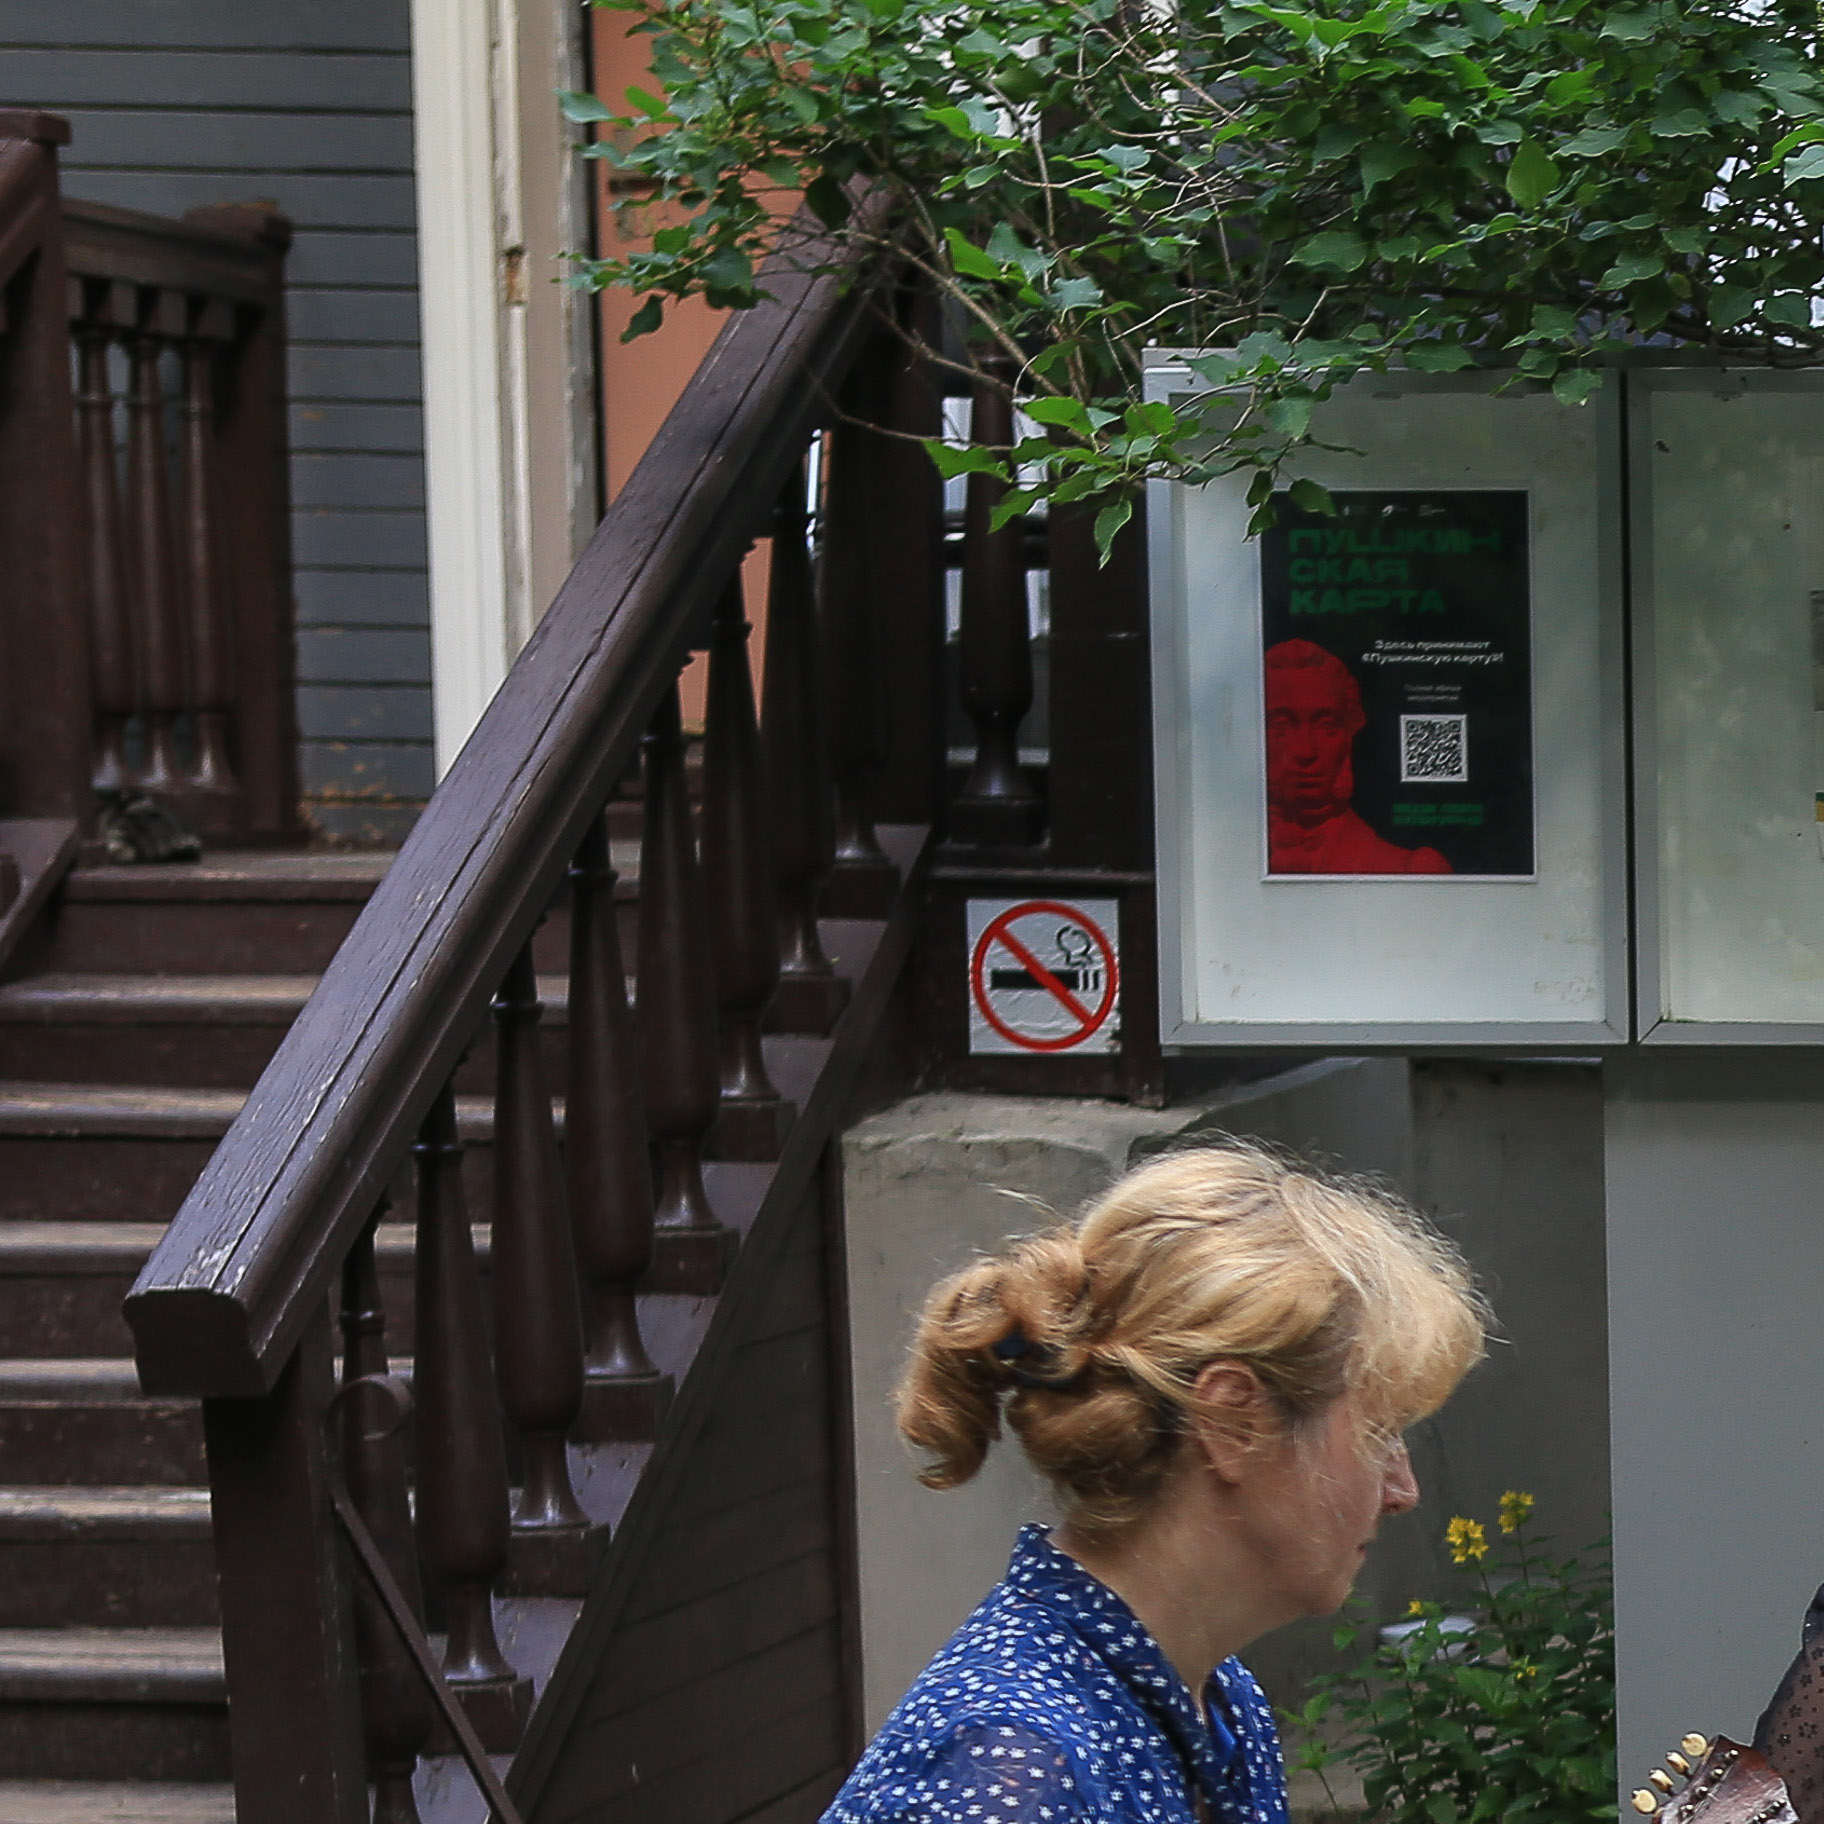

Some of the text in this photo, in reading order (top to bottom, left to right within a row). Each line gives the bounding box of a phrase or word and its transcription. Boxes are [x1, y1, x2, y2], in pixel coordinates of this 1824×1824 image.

[1288, 528, 1503, 554] ПУШКИН
[1288, 557, 1409, 584] СКАЯ
[1288, 588, 1447, 615] КАРТА
[1374, 638, 1415, 651] Здесь
